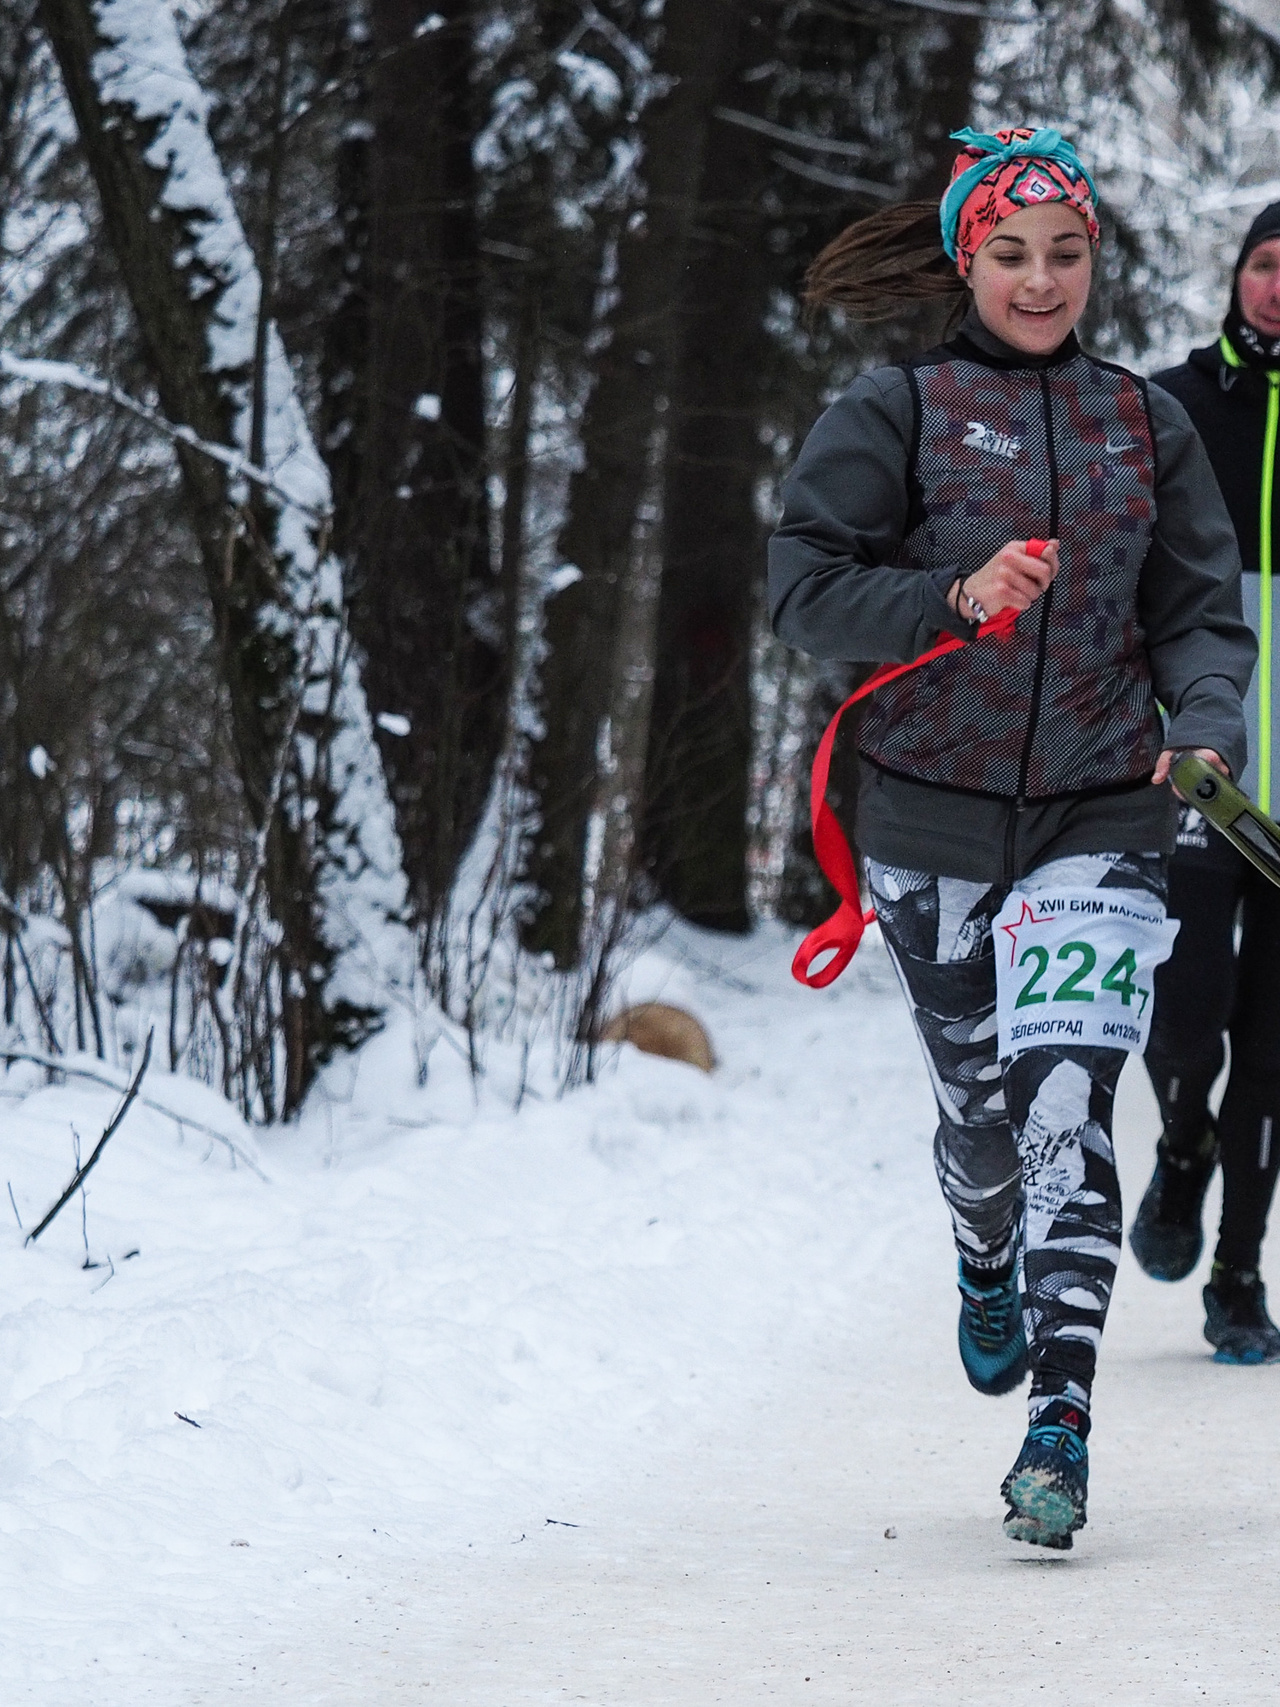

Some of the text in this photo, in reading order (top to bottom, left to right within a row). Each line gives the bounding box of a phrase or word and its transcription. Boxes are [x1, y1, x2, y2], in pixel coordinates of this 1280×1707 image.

[1037, 899, 1065, 913] XVII
[1070, 900, 1104, 914] БИМ
[1011, 1020, 1083, 1041] ЗЕЛЕНОГРАД
